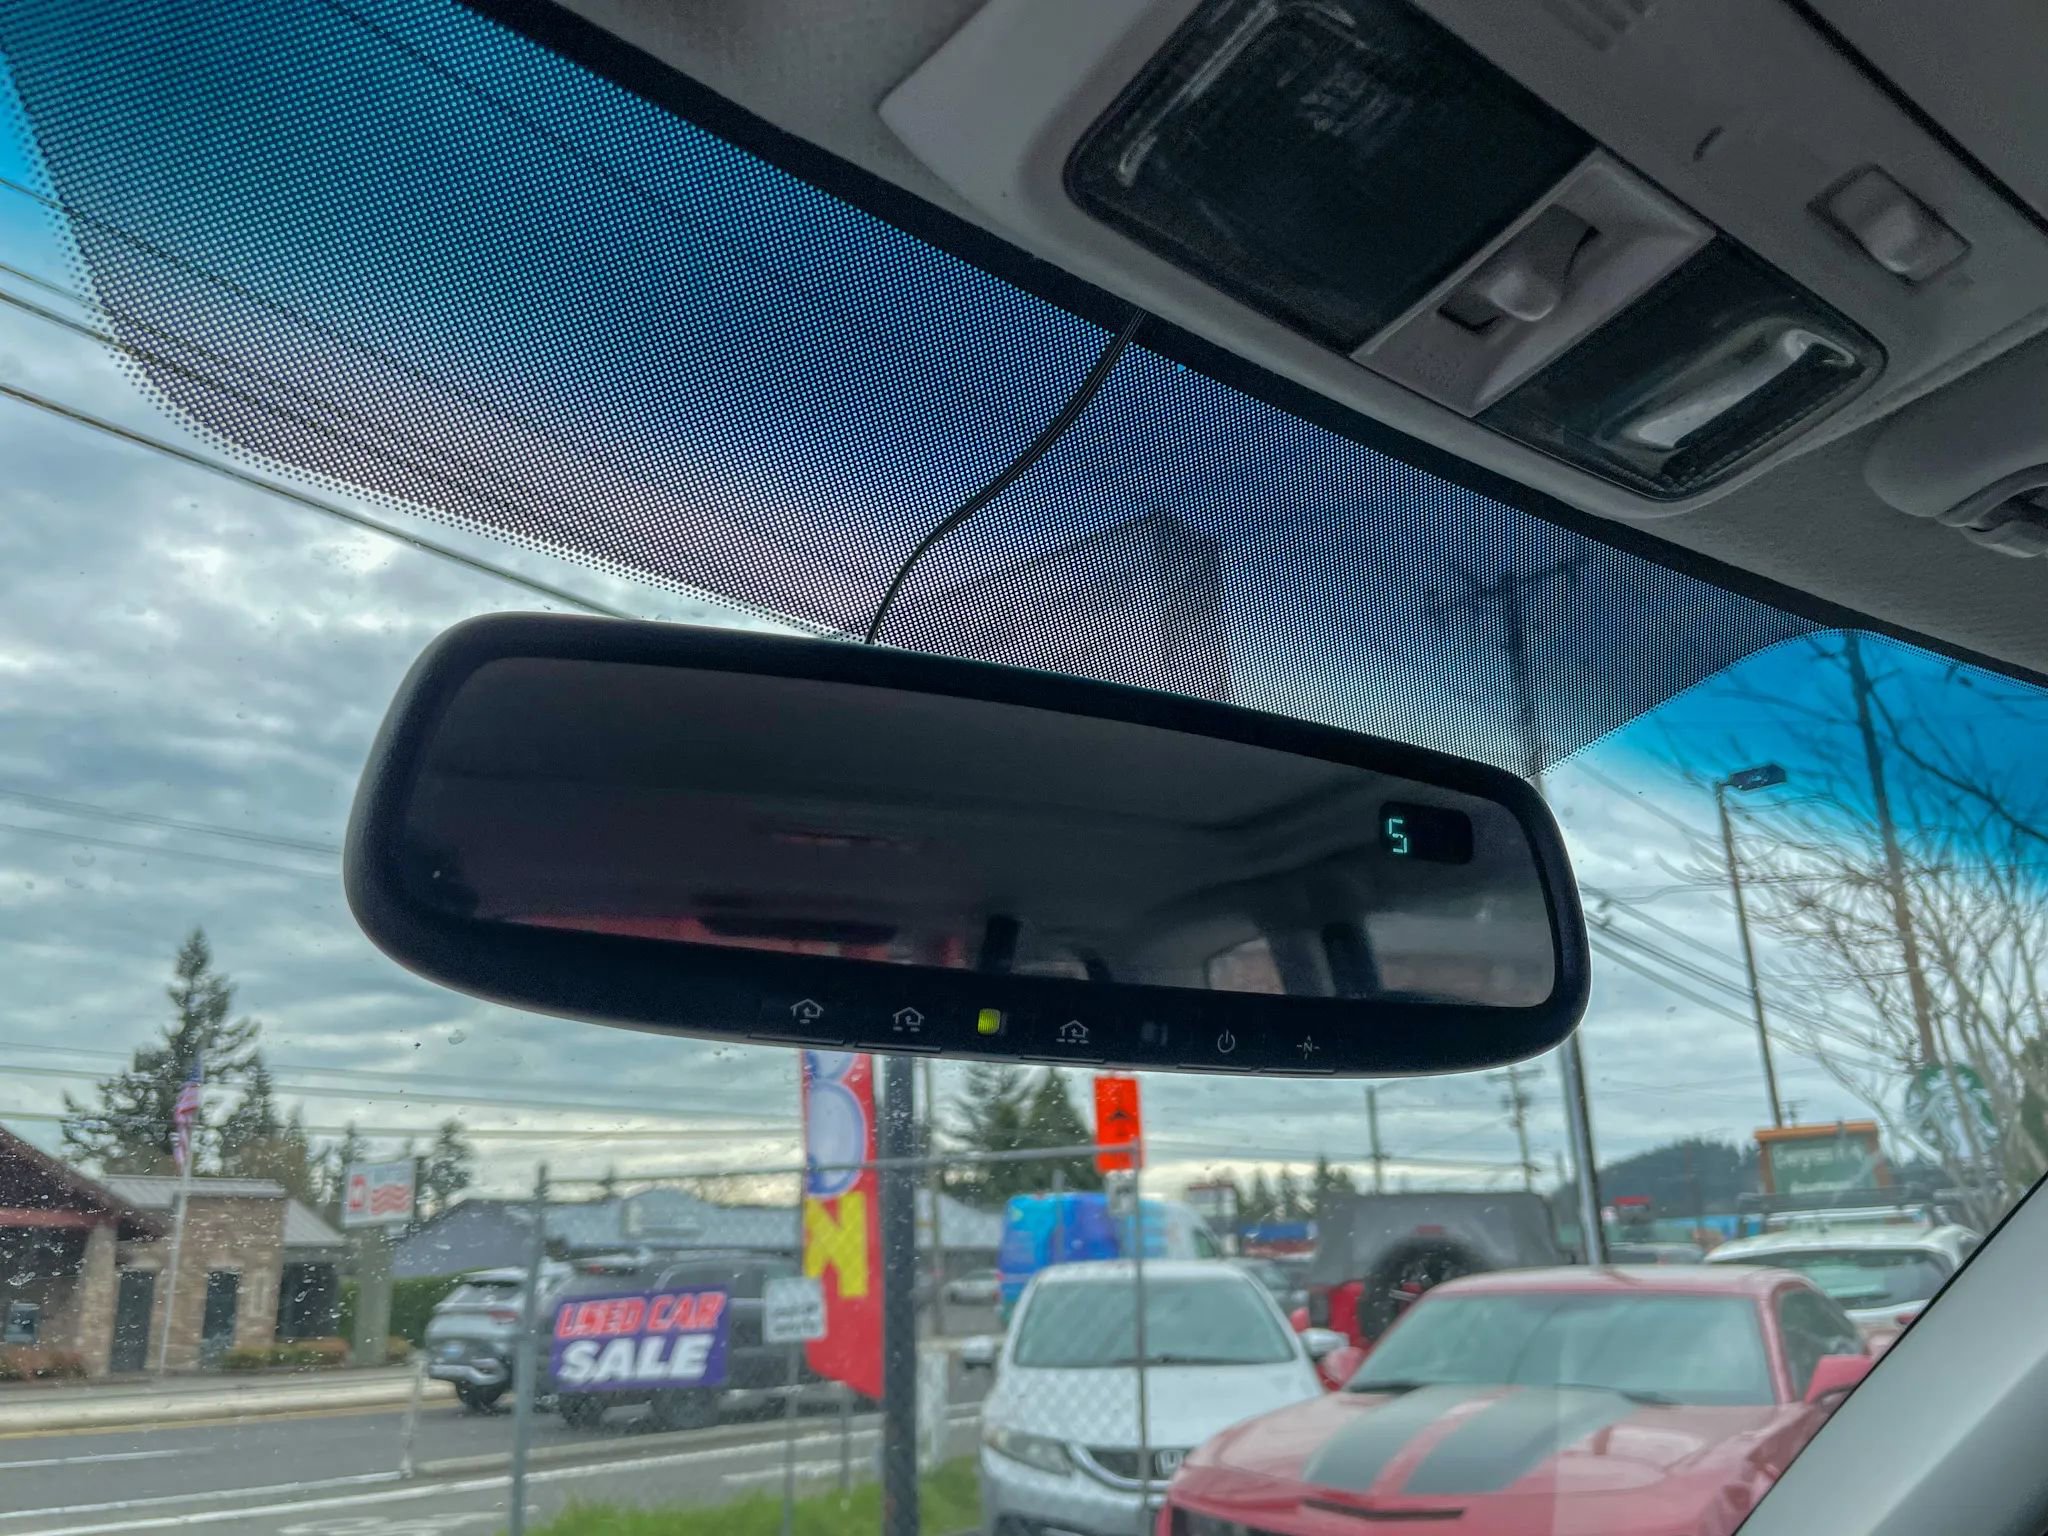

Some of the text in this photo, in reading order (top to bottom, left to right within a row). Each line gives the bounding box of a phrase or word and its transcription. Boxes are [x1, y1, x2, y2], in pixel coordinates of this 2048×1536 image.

[557, 1291, 727, 1338] USED CAR
[557, 1334, 714, 1385] SALE
